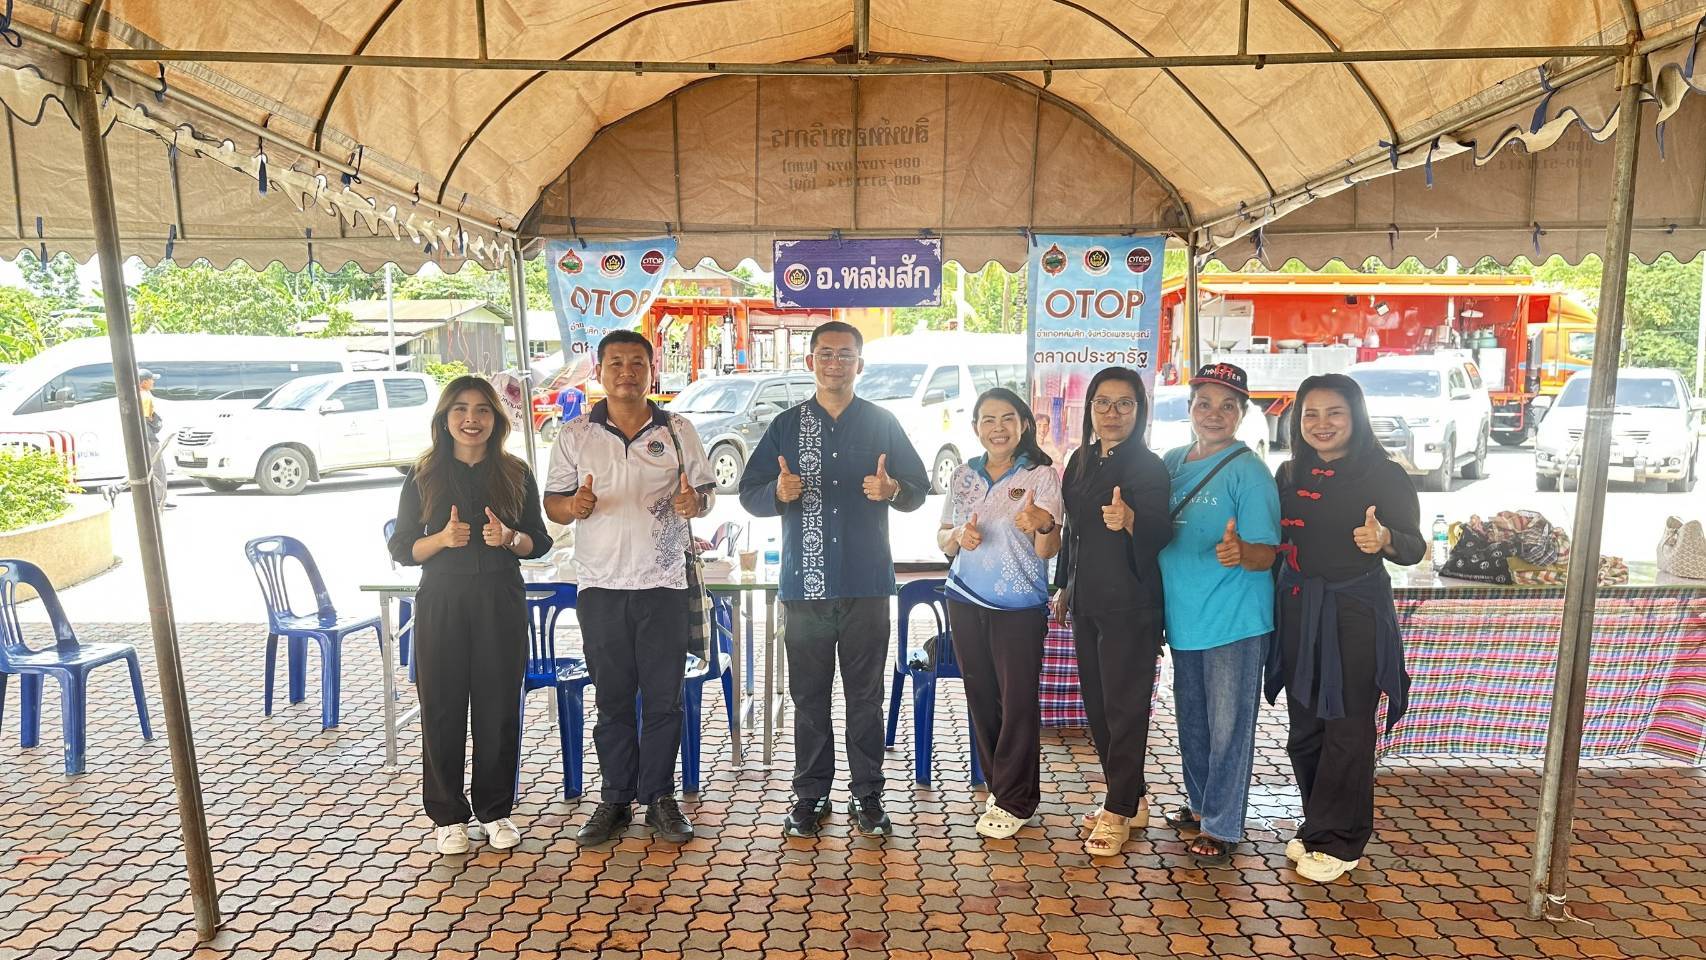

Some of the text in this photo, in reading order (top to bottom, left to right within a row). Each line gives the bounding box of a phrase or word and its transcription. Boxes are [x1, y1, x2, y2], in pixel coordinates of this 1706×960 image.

[816, 253, 931, 289] อ.หล่มสัก
[570, 286, 652, 318] OTOP
[1045, 289, 1145, 319] OTOP
[1033, 346, 1148, 369] ตลาดประชารัฐ
